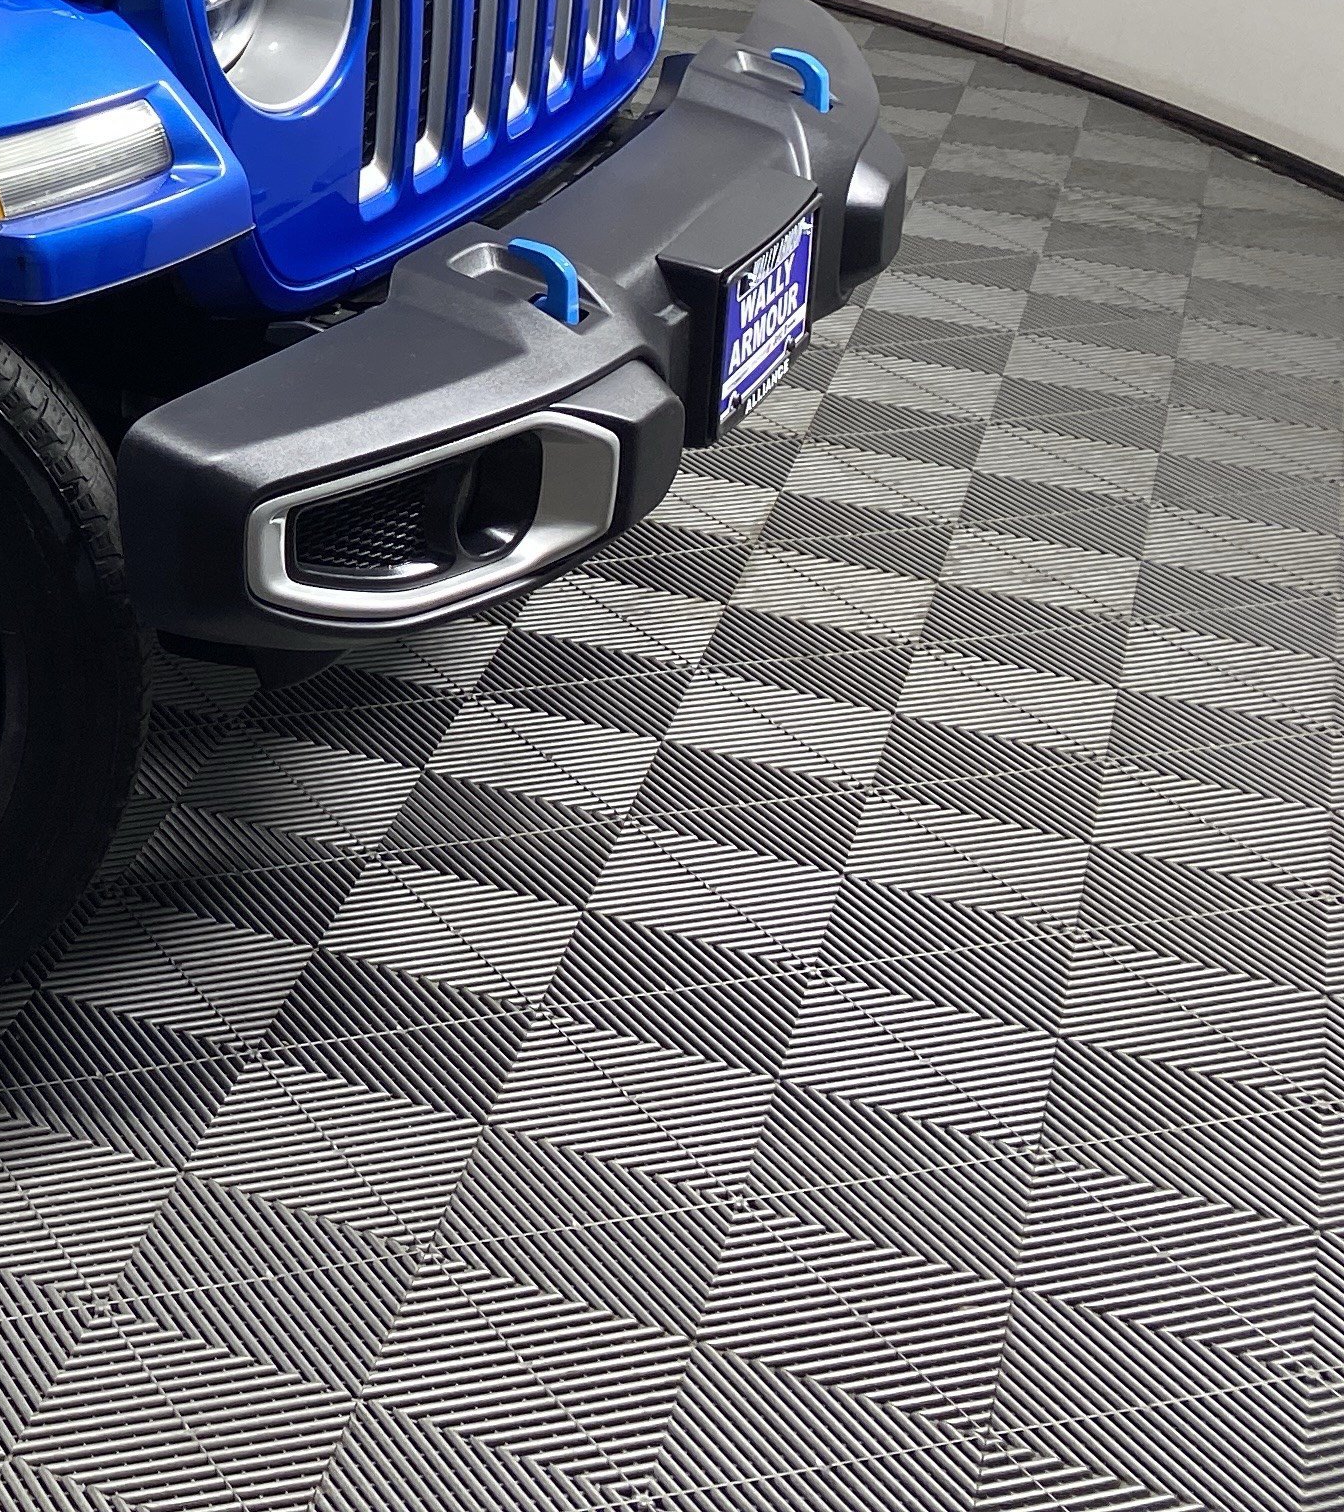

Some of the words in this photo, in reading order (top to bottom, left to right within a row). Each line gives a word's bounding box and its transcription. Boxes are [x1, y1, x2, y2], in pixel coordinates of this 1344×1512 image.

[727, 281, 800, 376] ARMOUR
[739, 251, 796, 330] WALLY
[744, 357, 790, 416] ALLIANCE
